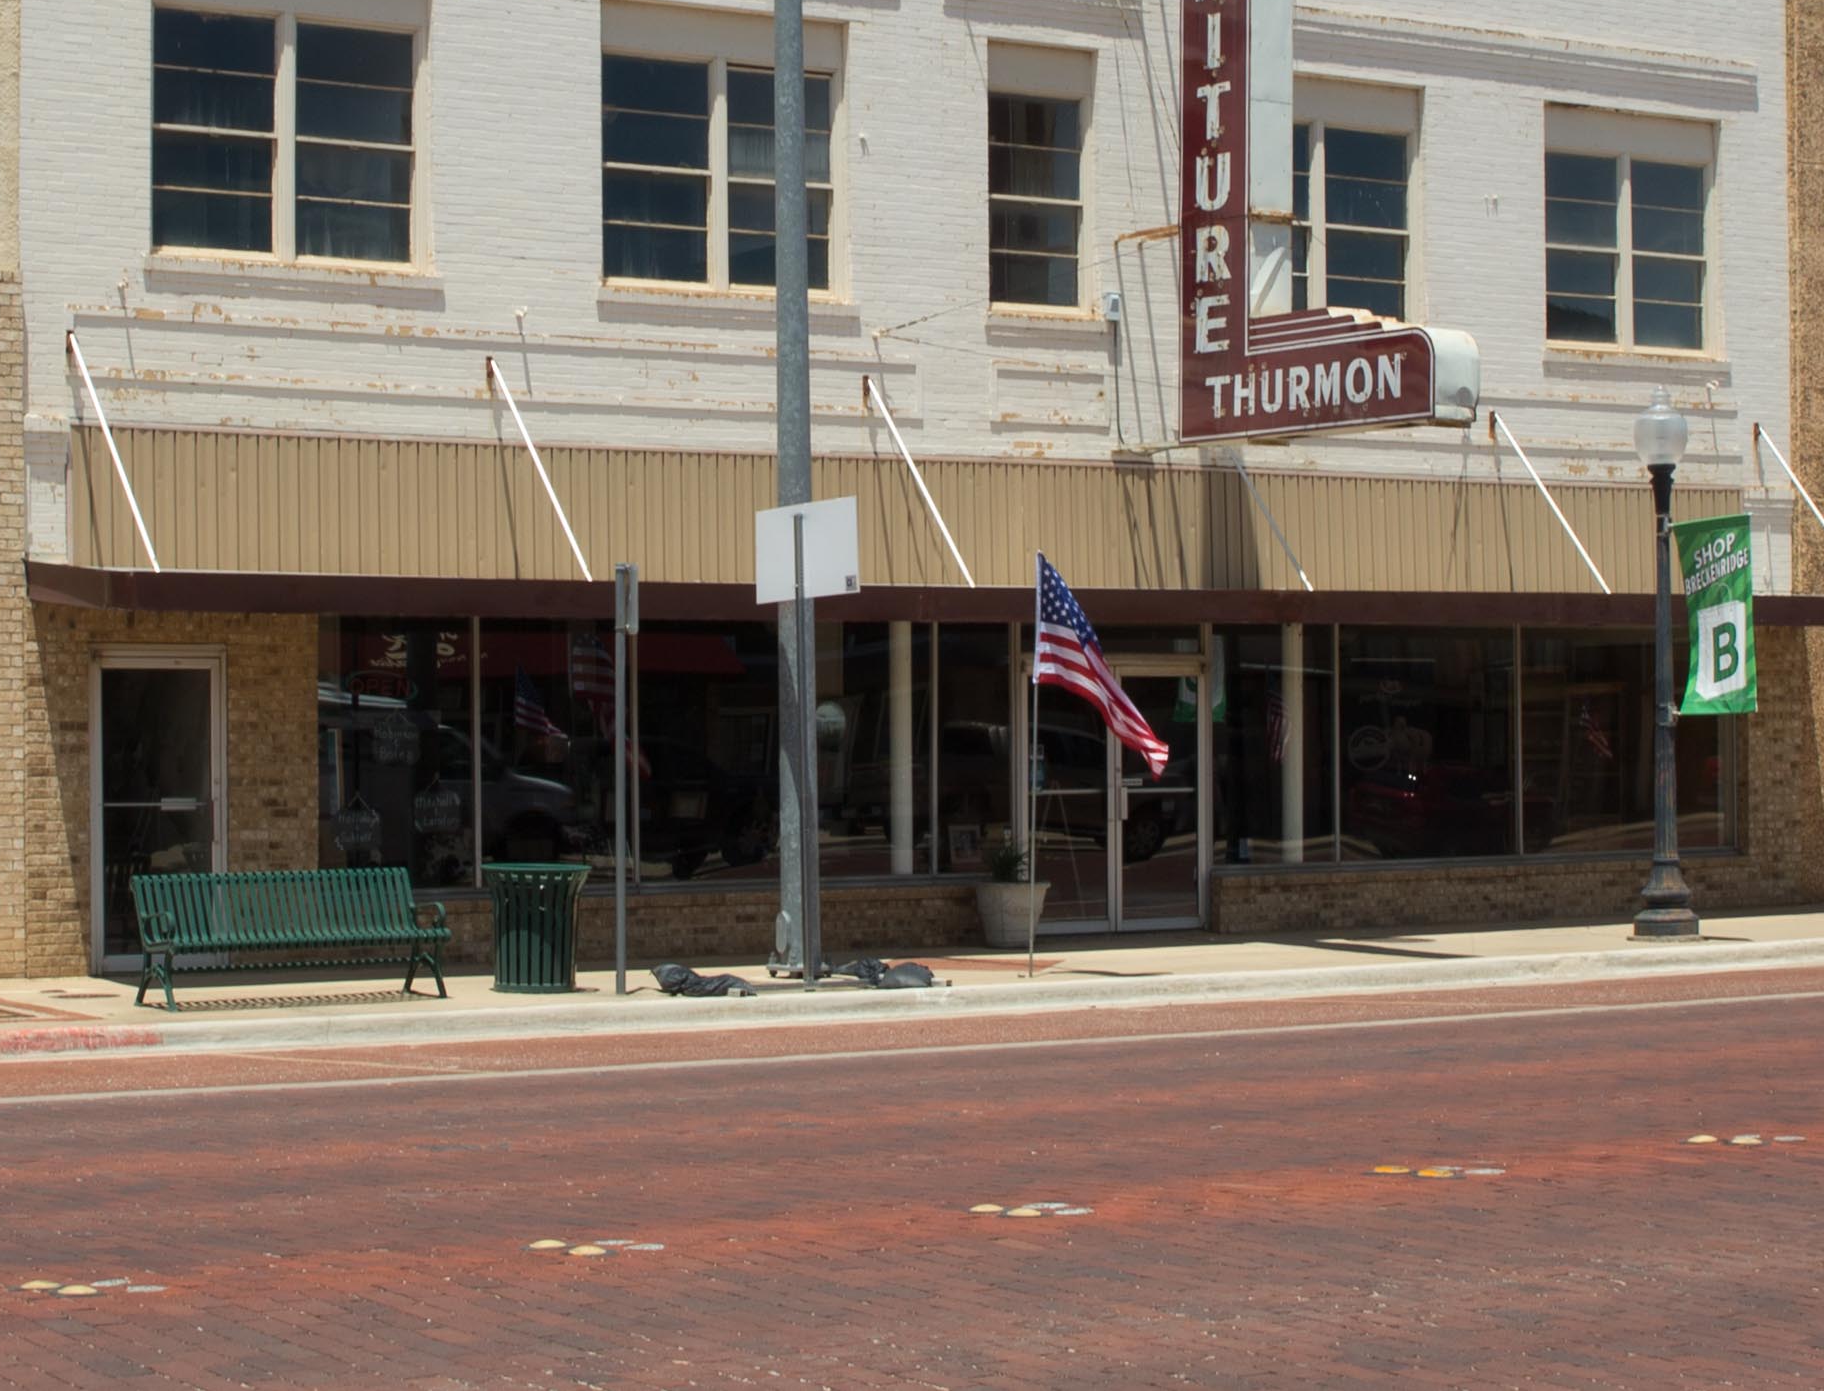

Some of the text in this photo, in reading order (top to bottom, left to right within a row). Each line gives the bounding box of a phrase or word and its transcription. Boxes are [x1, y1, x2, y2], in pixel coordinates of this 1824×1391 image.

[1205, 352, 1403, 420] THURMON
[1684, 547, 1750, 596] BRECKENRIDGE
[1694, 532, 1736, 569] SHOP
[1713, 621, 1739, 683] B
[348, 677, 412, 699] OPEN
